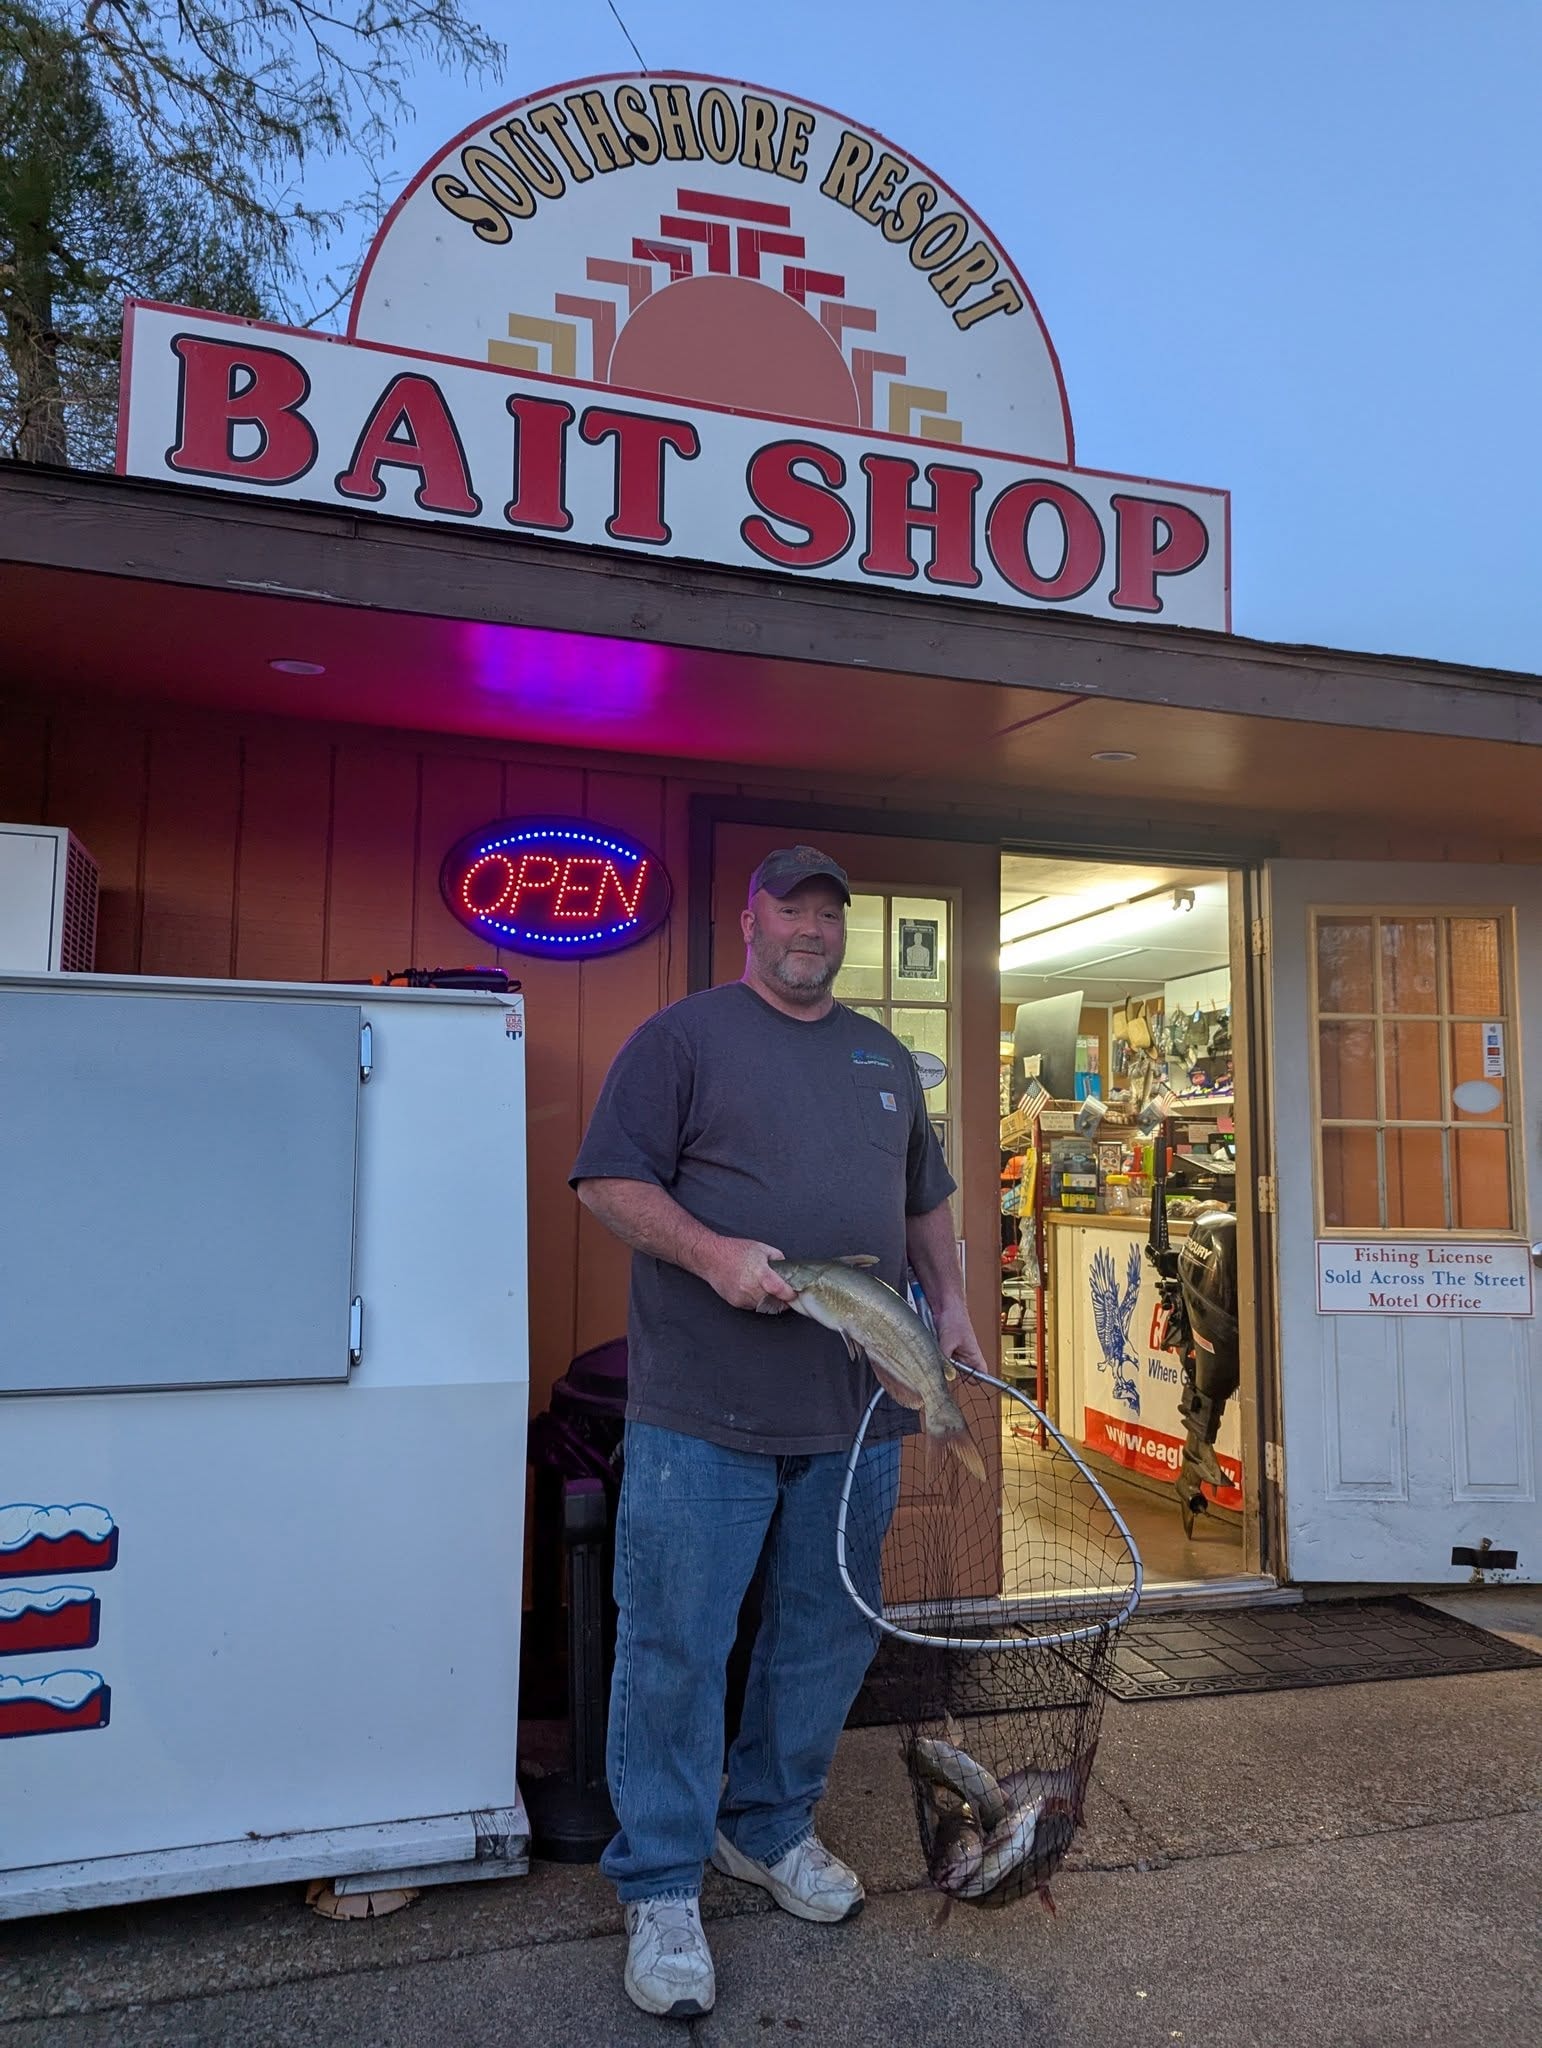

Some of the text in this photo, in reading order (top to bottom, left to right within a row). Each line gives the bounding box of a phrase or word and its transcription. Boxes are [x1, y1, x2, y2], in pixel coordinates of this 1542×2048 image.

[431, 83, 1024, 332] SOUTHSHORE RESORT
[165, 332, 1210, 616] BAIT SHOP
[462, 853, 649, 917] OPEN
[1354, 1247, 1493, 1269] Fishing License
[1325, 1269, 1526, 1287] Sold Across The Street
[1368, 1292, 1482, 1309] Motel Office
[1148, 1357, 1178, 1384] Where
